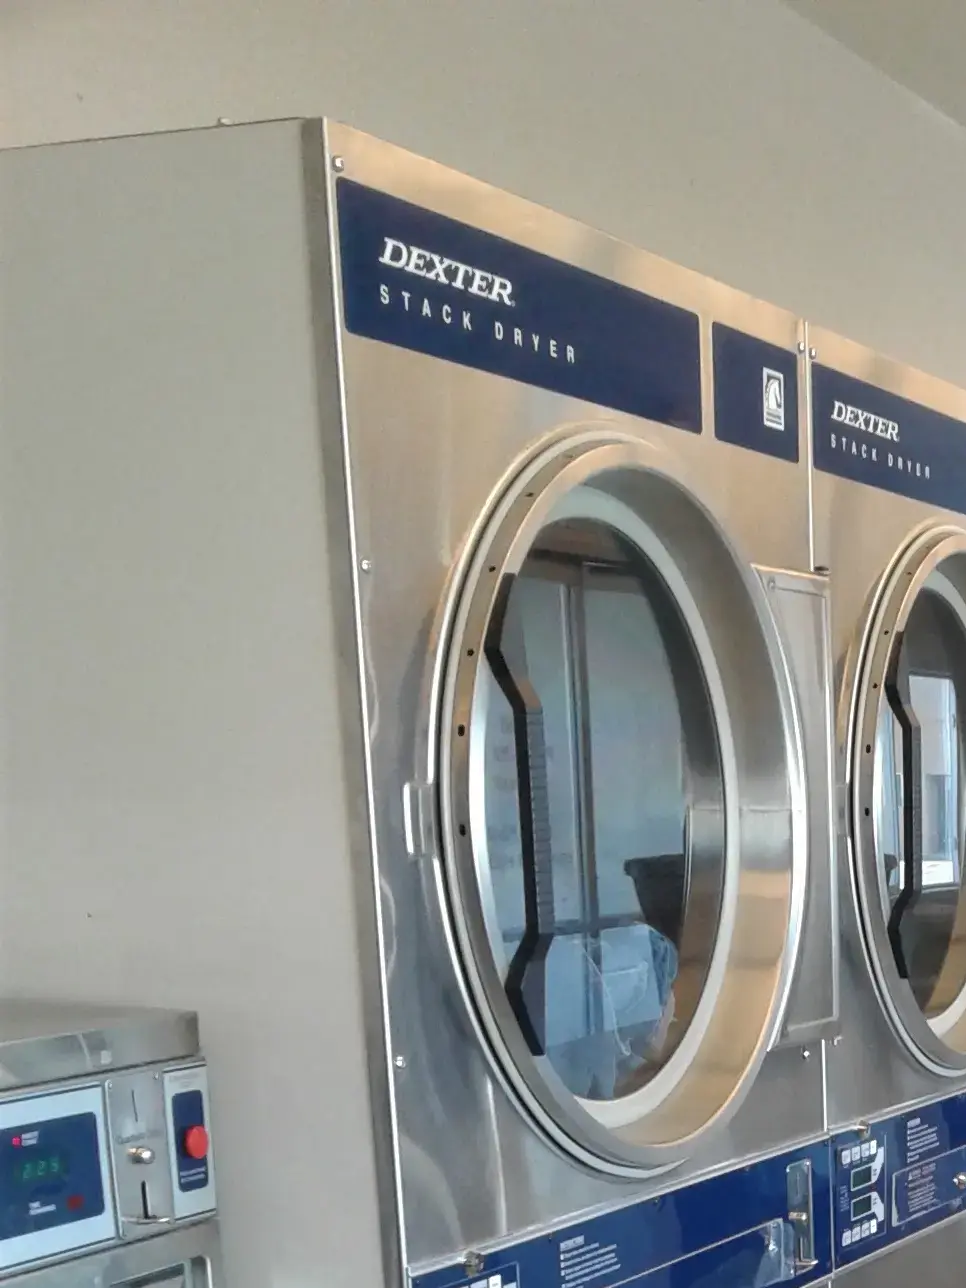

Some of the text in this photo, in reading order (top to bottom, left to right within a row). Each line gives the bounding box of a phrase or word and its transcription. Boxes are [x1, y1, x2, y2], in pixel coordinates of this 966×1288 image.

[378, 236, 514, 307] DEXTER
[379, 284, 576, 364] STACK DRYER
[831, 400, 900, 442] DEXTER
[831, 433, 930, 479] STACK DRYER
